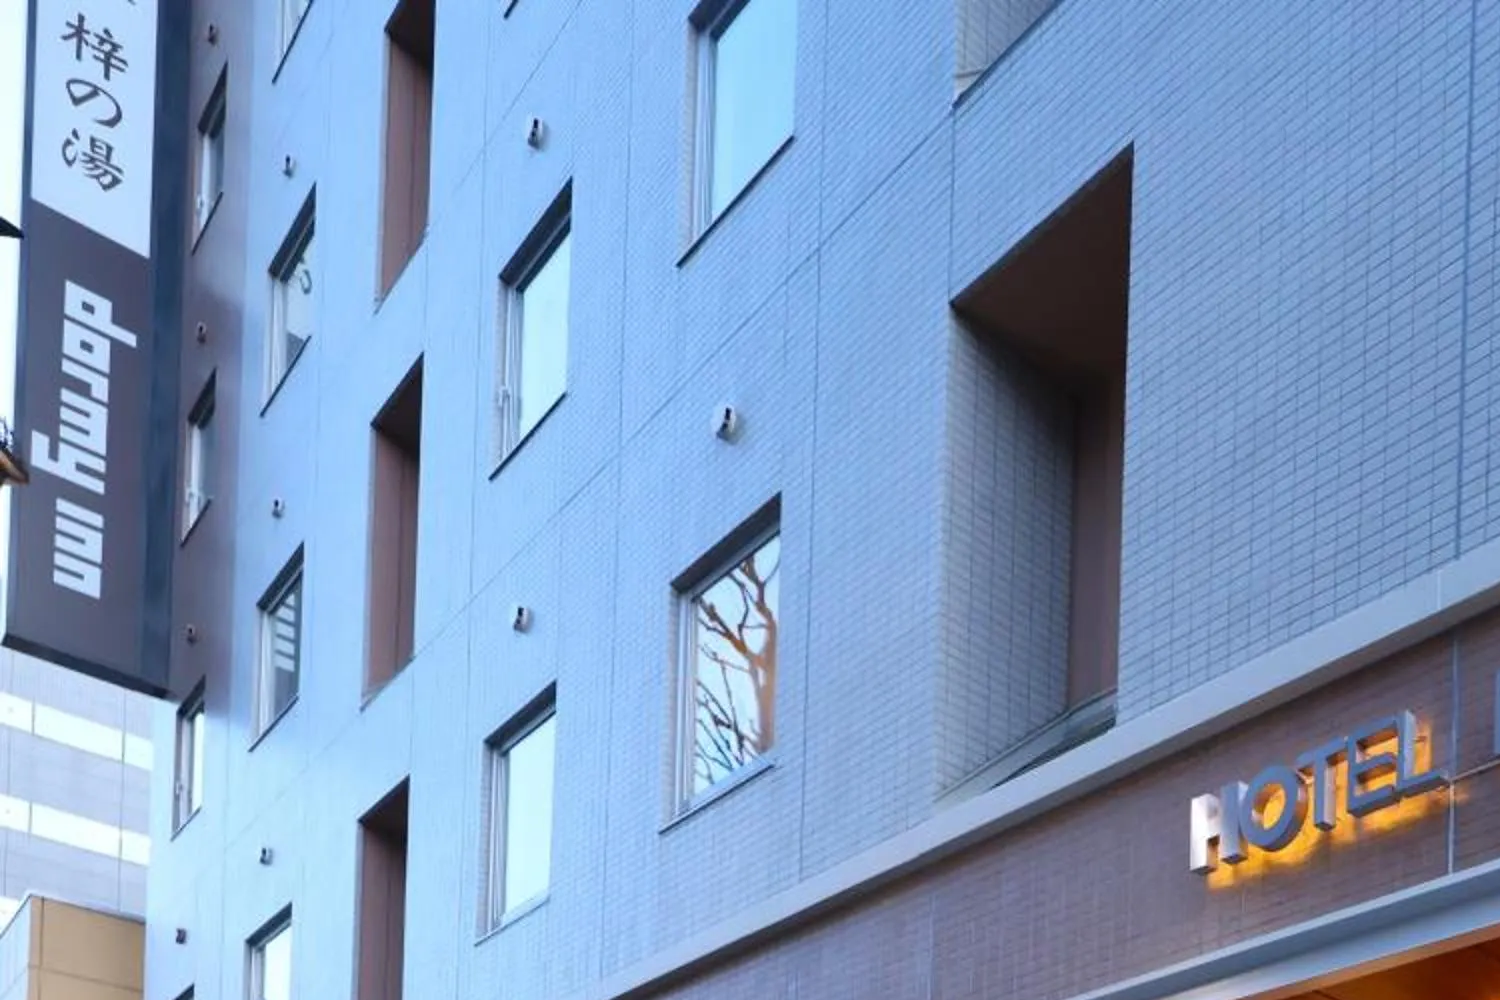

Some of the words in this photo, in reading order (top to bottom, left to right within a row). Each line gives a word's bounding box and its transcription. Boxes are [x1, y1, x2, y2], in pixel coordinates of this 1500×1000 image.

[60, 12, 129, 192] 梓の湯
[31, 279, 137, 495] dormy
[53, 497, 105, 600] inn
[1190, 709, 1449, 875] HOTEL
